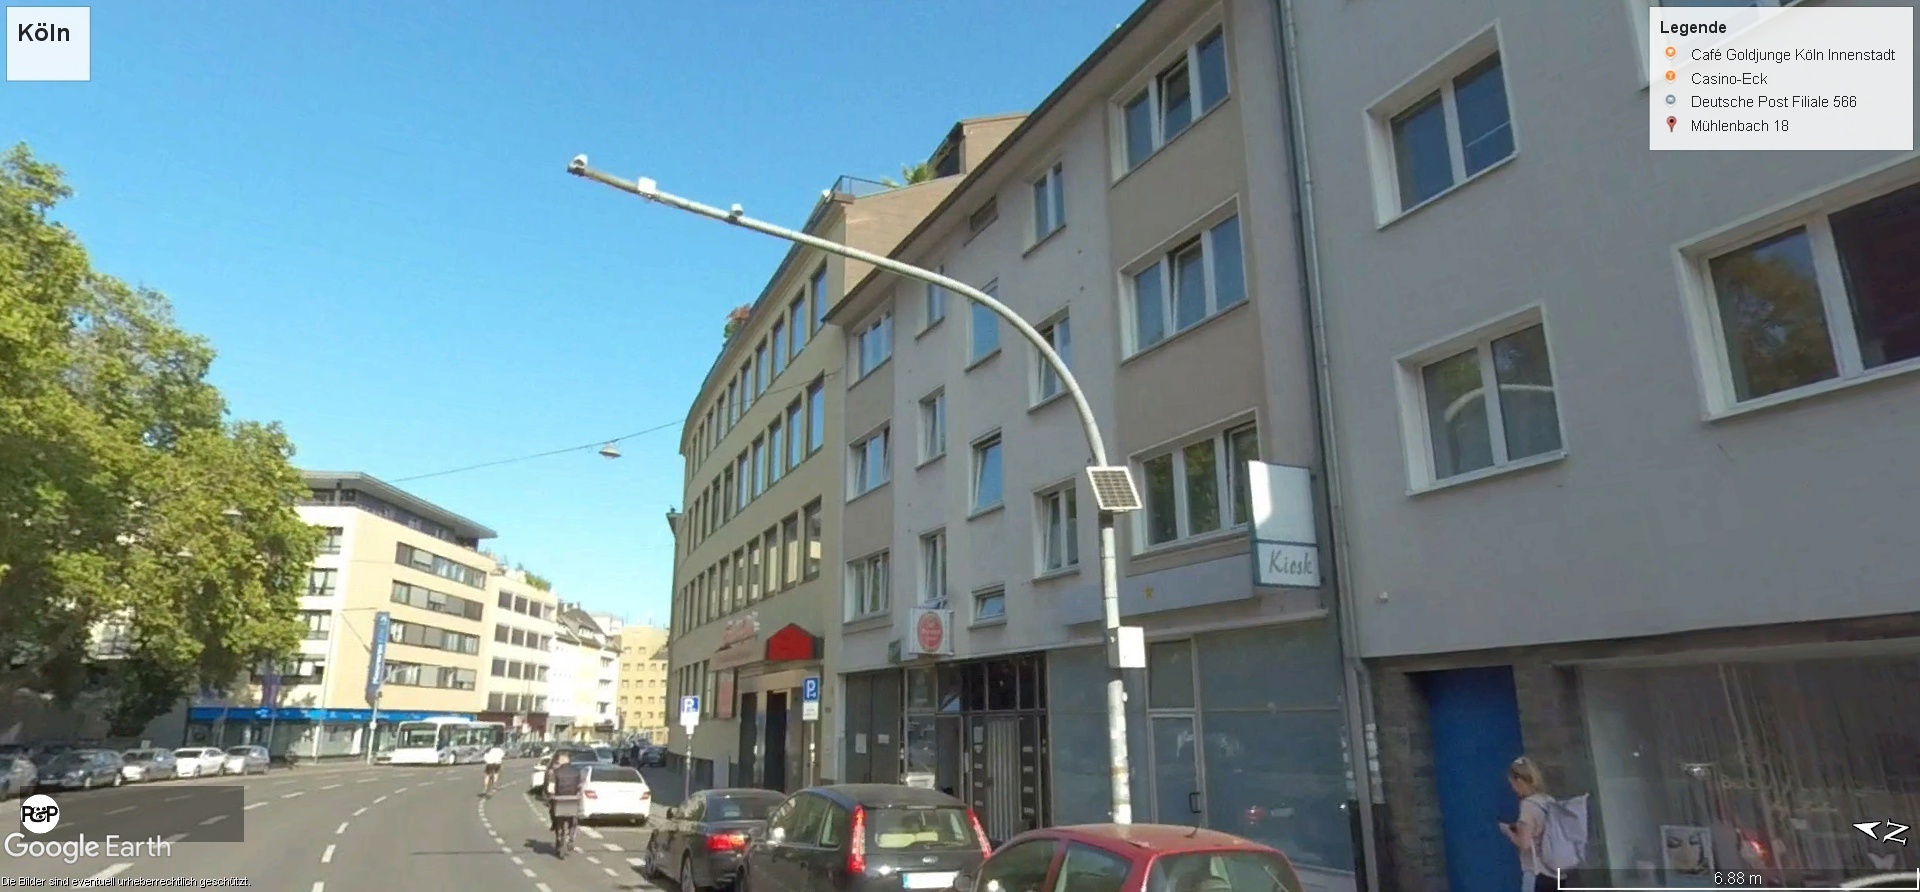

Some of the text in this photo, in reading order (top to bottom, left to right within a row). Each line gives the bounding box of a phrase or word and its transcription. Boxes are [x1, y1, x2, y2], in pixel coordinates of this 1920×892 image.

[1268, 549, 1313, 575] Kiosk
[806, 680, 816, 698] P
[684, 698, 695, 711] P
